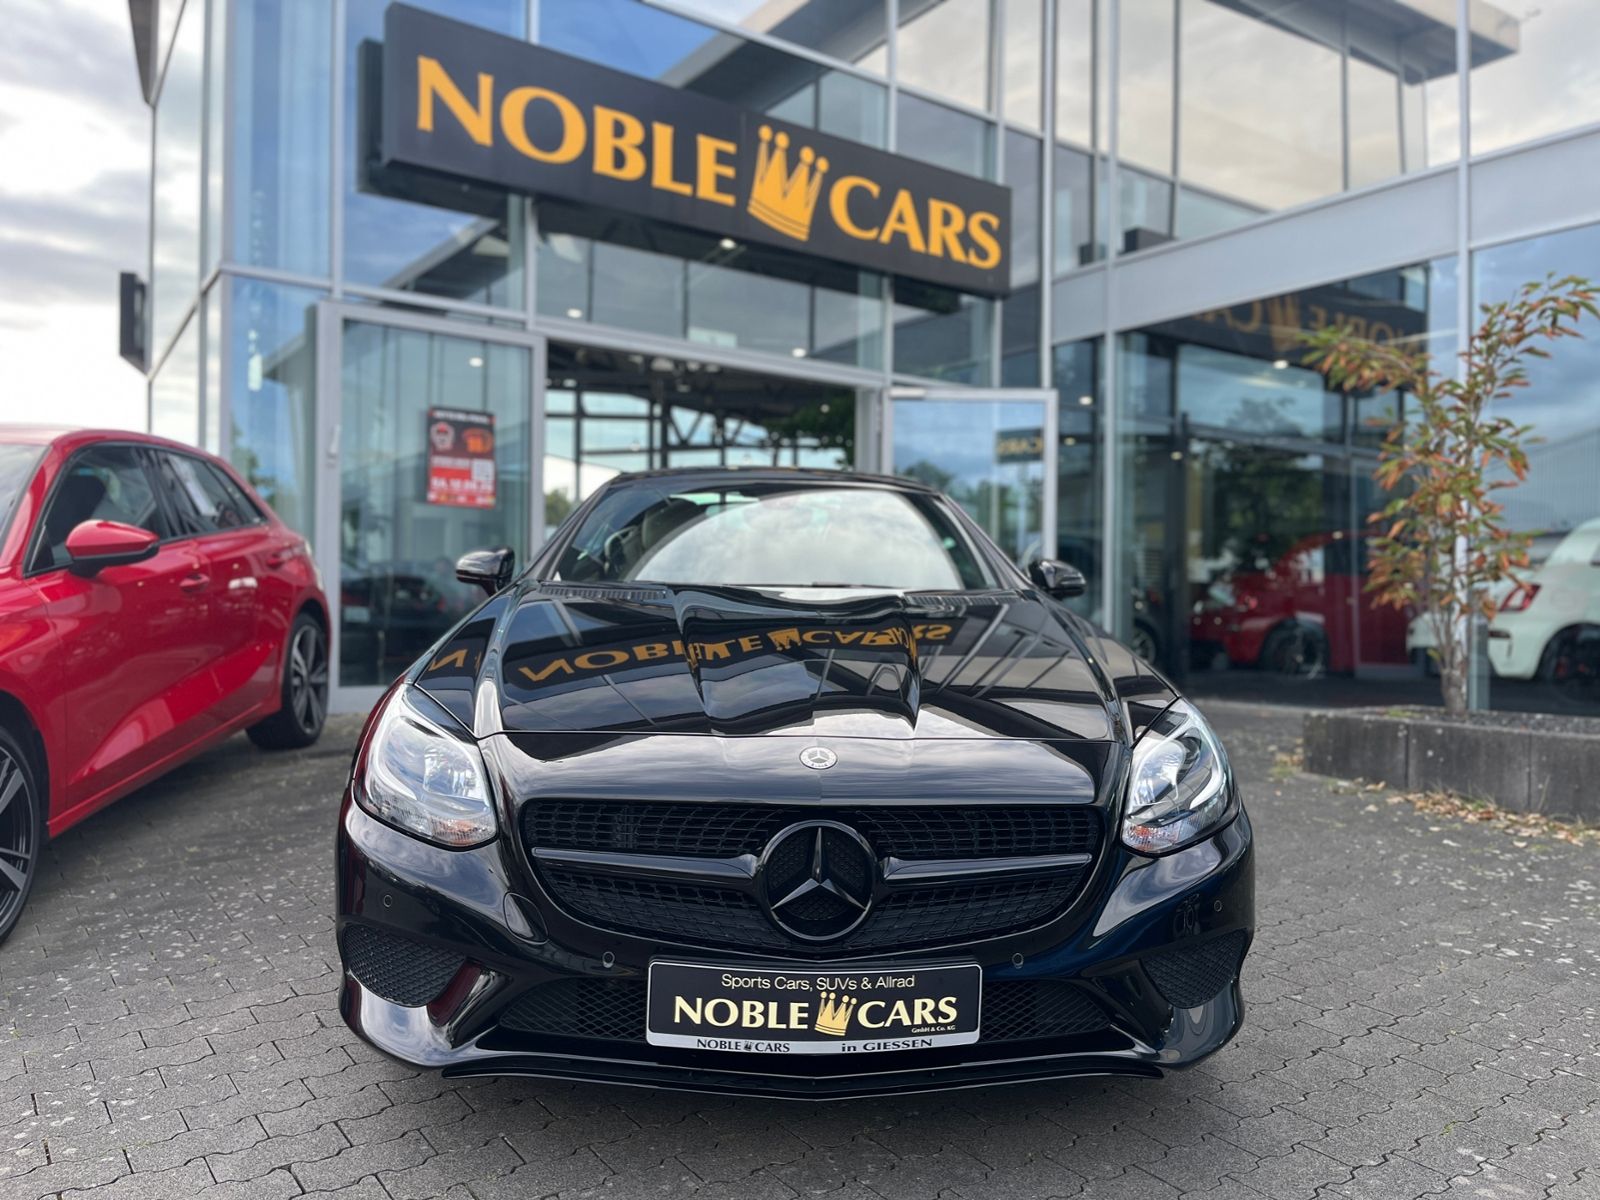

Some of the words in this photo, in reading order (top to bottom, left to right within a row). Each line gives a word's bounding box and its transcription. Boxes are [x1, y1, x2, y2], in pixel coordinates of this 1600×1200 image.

[416, 55, 737, 207] NOBLE
[829, 175, 1002, 270] CARS
[721, 973, 771, 990] Sports
[774, 976, 813, 992] Cars,
[816, 977, 857, 990] SUVs
[860, 976, 872, 990] &
[875, 975, 915, 989] Allrad
[674, 995, 809, 1029] NOBLE
[857, 996, 958, 1029] CARS
[697, 1038, 741, 1051] NOBLE
[754, 1042, 790, 1053] CARS
[841, 1043, 857, 1052] in
[862, 1038, 933, 1051] GIESSEN
